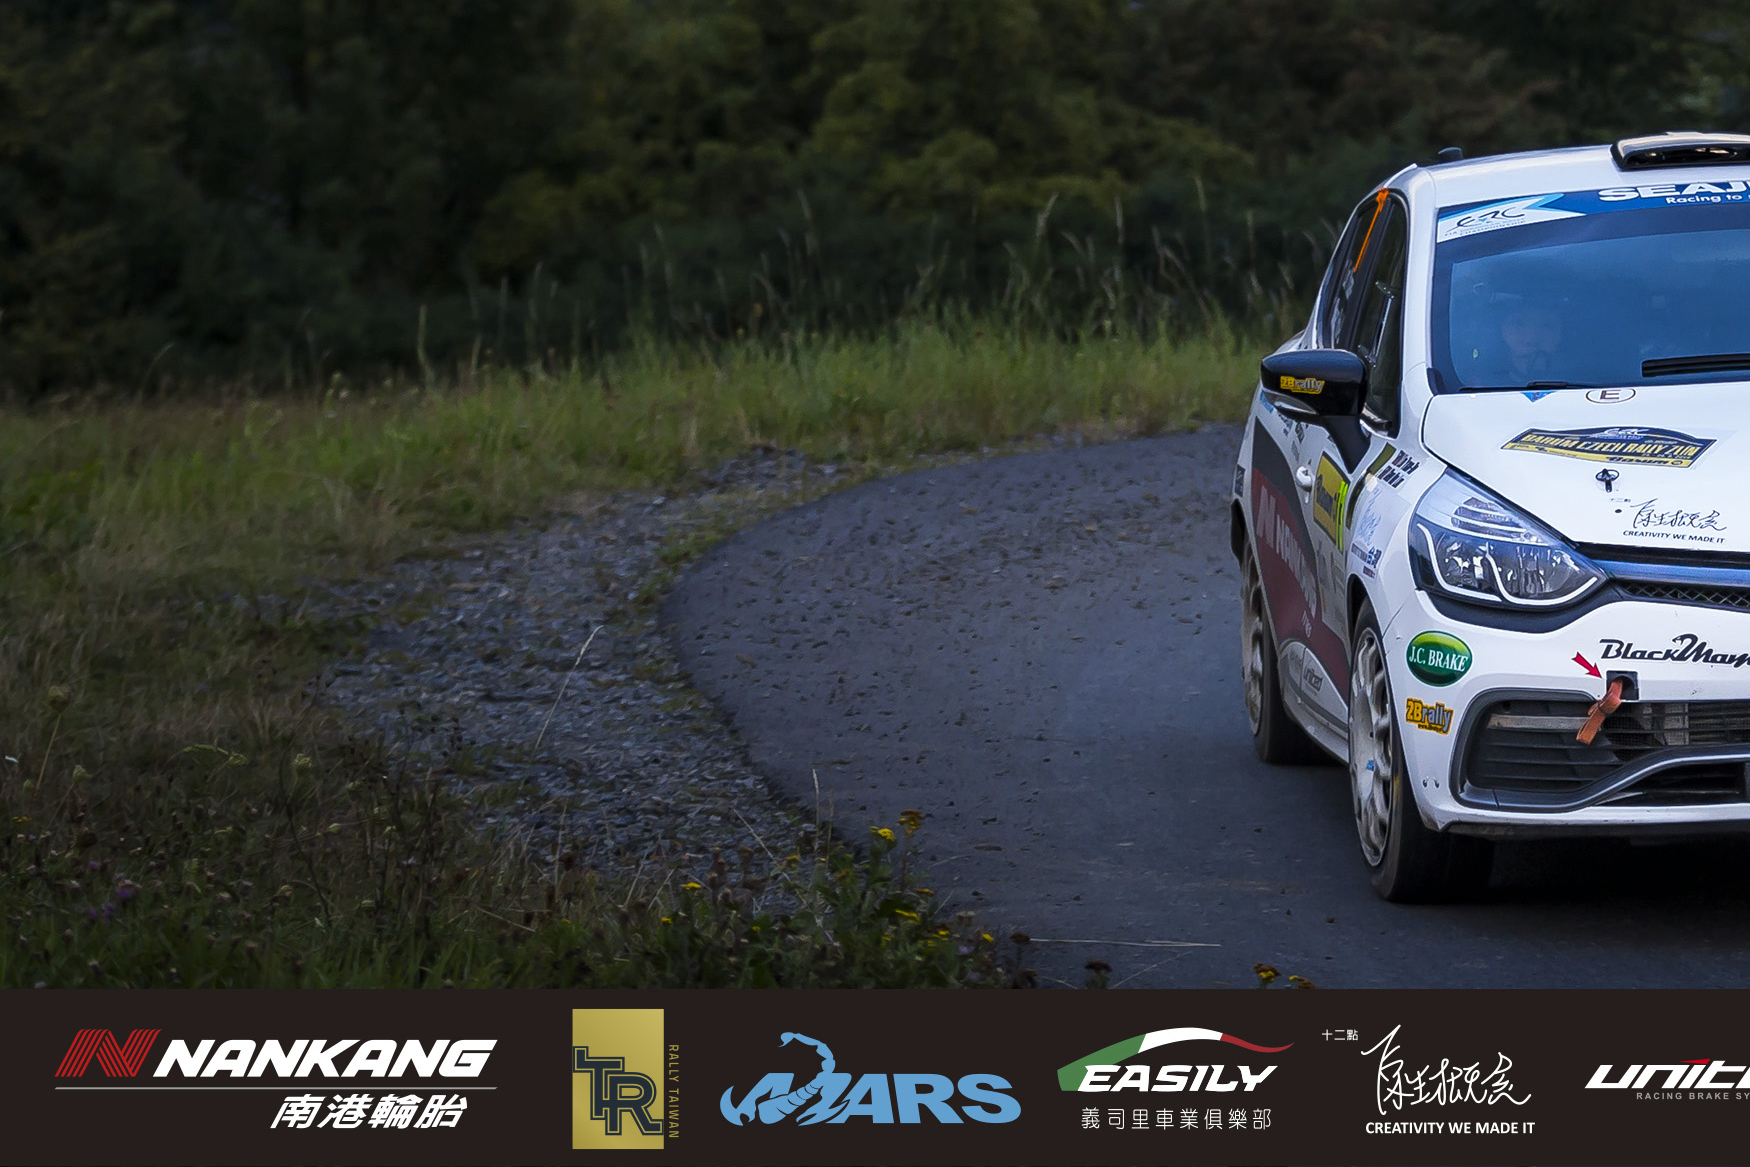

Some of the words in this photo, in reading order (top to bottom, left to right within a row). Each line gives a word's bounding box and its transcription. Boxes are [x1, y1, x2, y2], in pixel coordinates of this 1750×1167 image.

[1666, 194, 1721, 205] Racing
[1600, 390, 1620, 400] E
[1520, 434, 1579, 448] BARUM
[1576, 440, 1622, 452] CZECH
[1623, 443, 1668, 454] RALLY
[1623, 530, 1670, 539] CREATIVITY
[1688, 535, 1713, 543] MADE
[1409, 646, 1426, 665] J.C.
[1428, 649, 1468, 672] BRAKE
[1406, 700, 1451, 733] 2Brally
